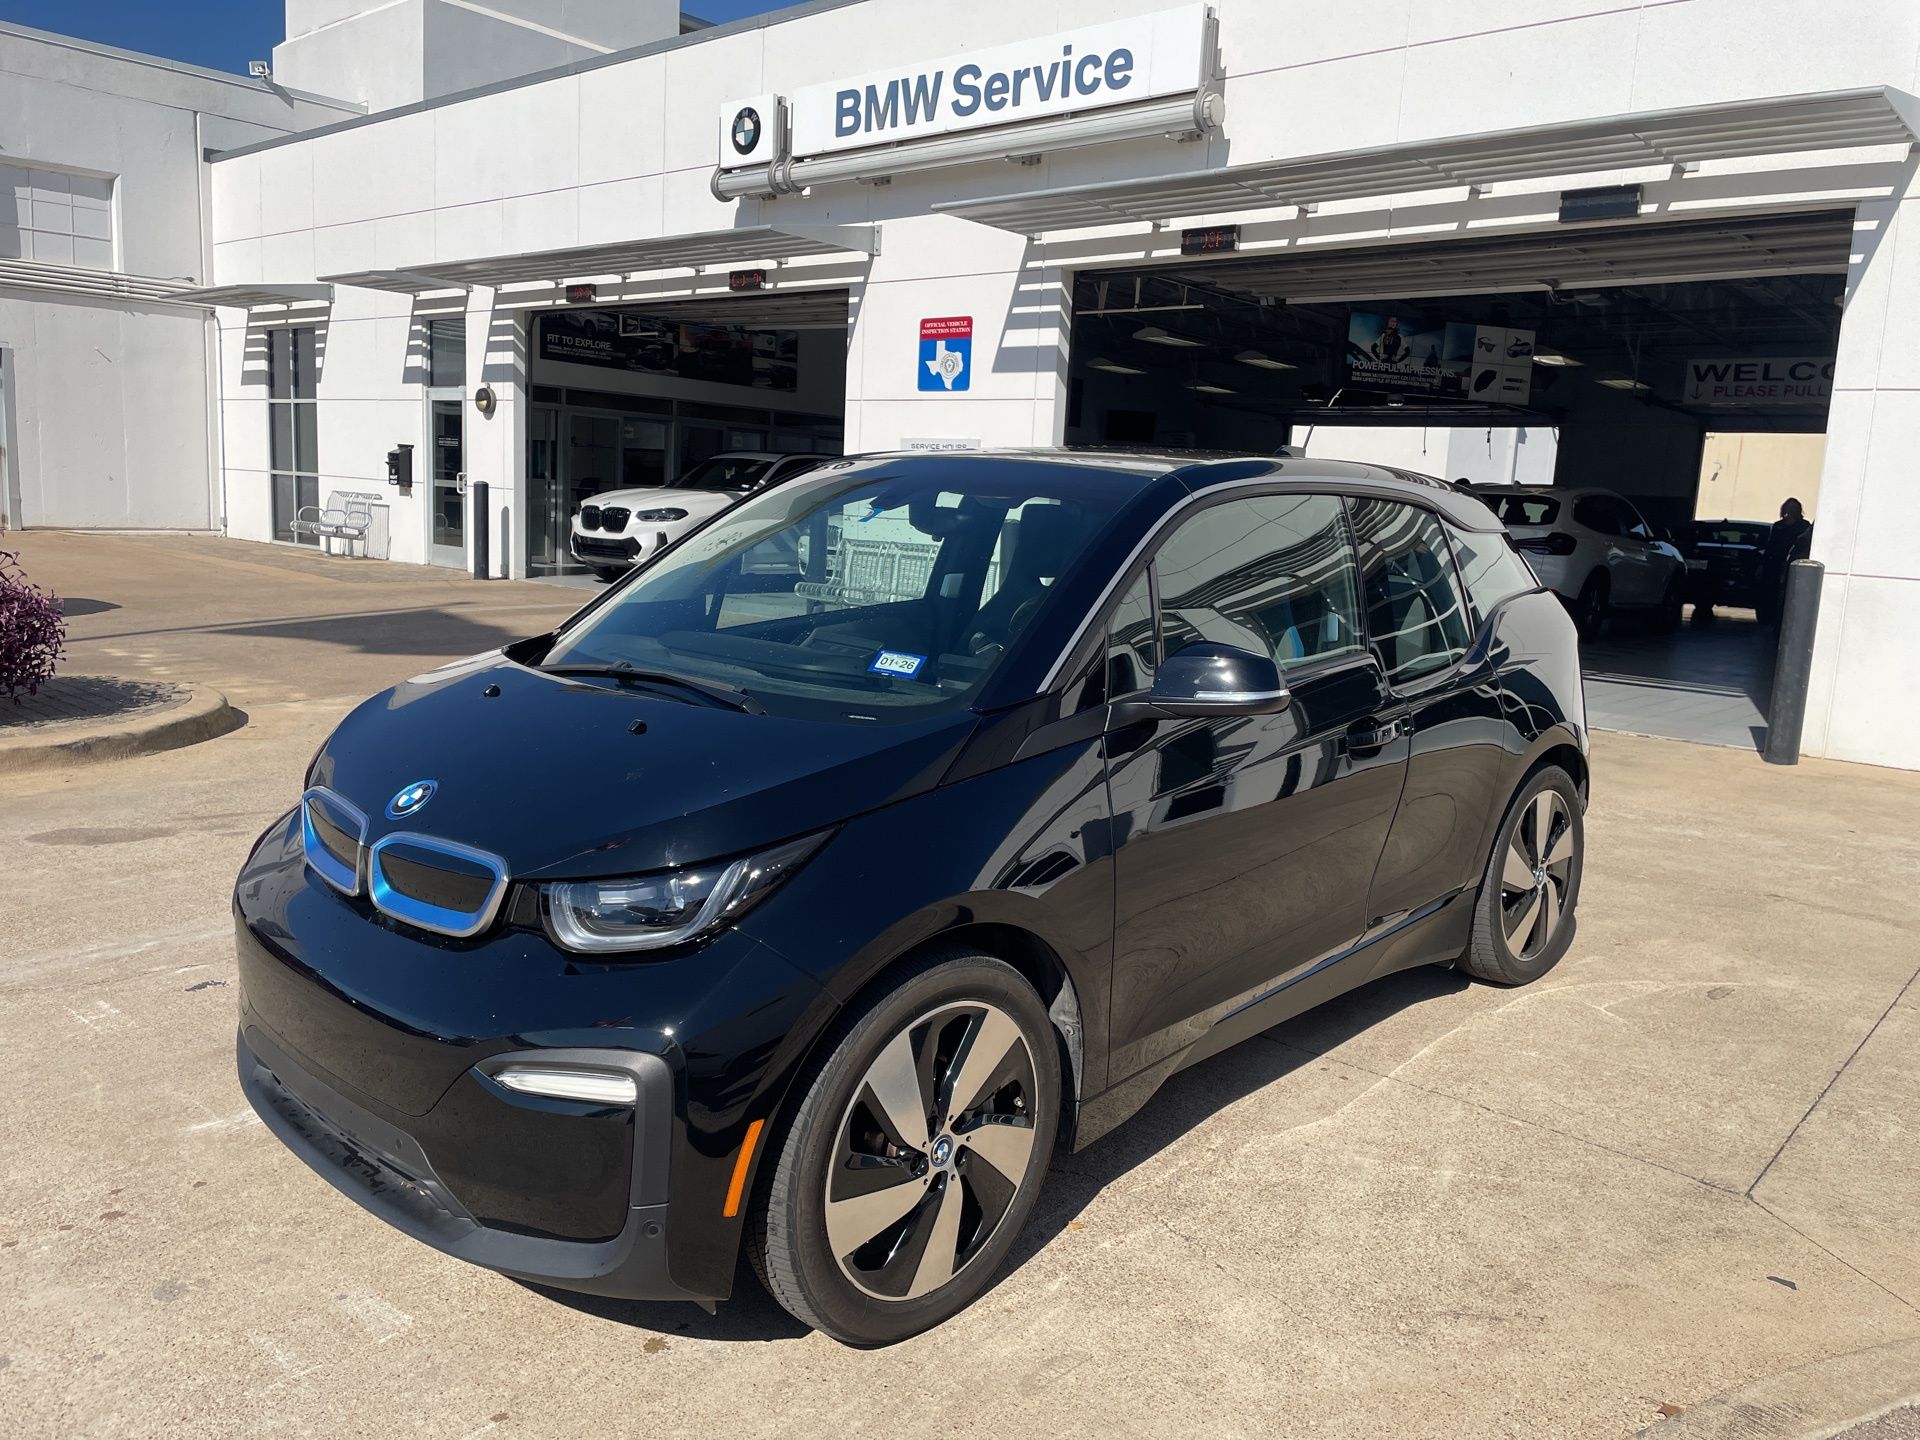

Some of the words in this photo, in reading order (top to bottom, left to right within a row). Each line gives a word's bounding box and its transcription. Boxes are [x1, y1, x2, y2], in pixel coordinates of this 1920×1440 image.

[835, 71, 944, 137] BMW
[951, 44, 1134, 117] Service
[546, 334, 560, 343] FIT
[561, 335, 574, 345] TO
[1352, 360, 1399, 373] POWERFUL
[1713, 385, 1778, 398] PLEASE
[1783, 384, 1827, 398] PULL
[880, 657, 894, 666] 01
[899, 660, 916, 670] 26
